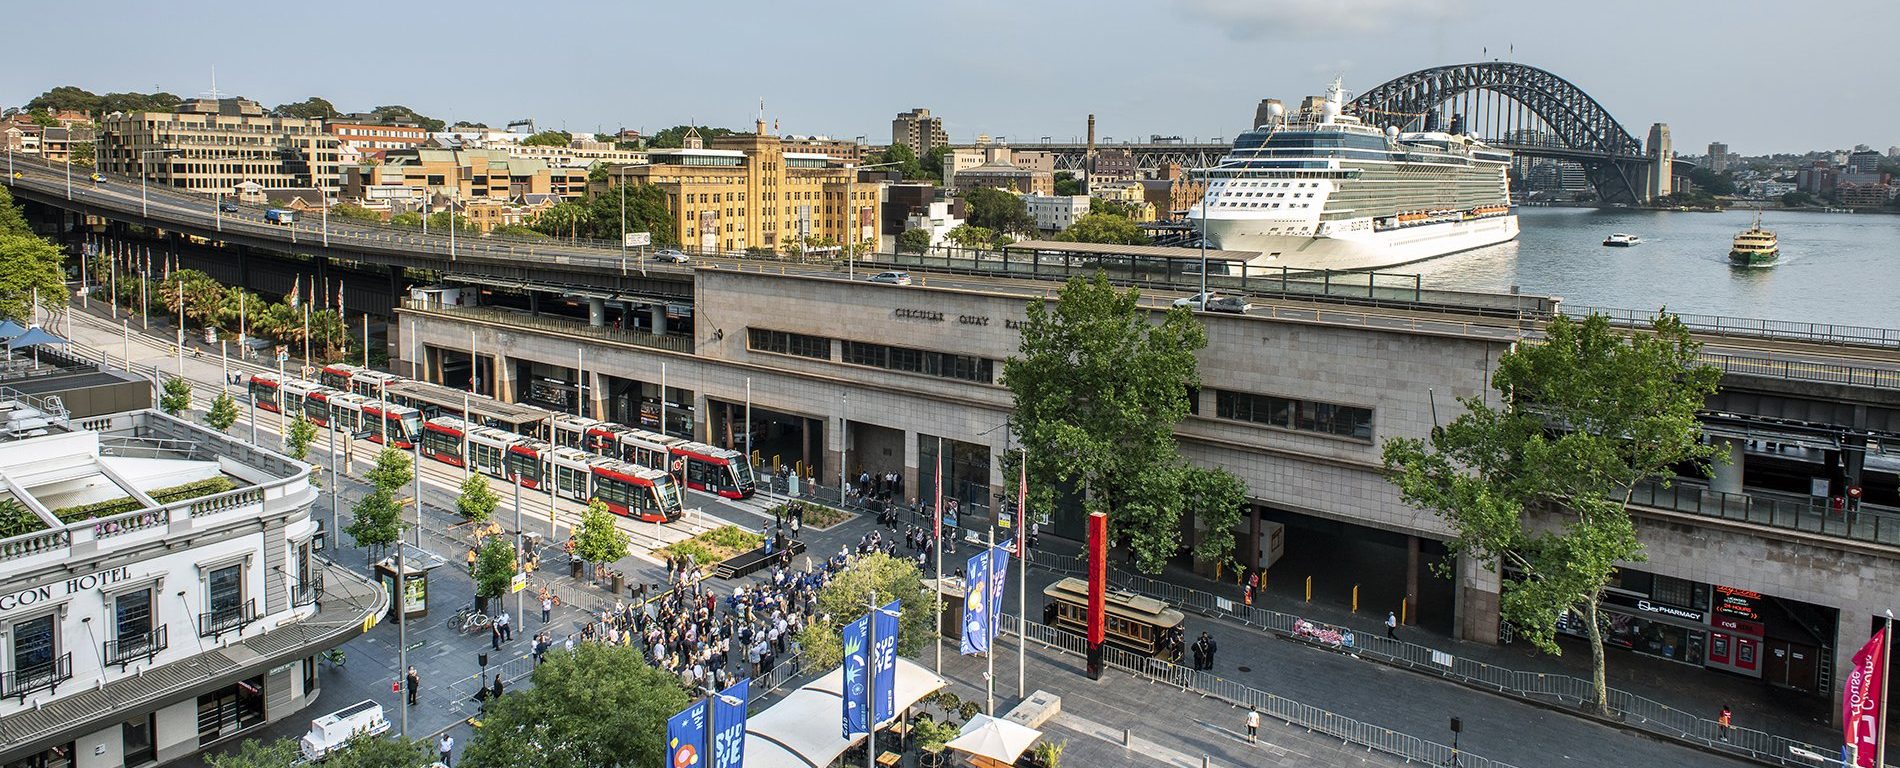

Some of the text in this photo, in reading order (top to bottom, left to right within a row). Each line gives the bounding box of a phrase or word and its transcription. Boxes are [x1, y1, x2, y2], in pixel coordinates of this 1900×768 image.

[895, 308, 945, 322] CIRCULAR
[959, 315, 990, 326] QUAY
[66, 566, 131, 594] HOTEL
[1659, 606, 1700, 620] PHARMACY
[691, 705, 704, 730] NYE
[716, 723, 743, 758] SYD
